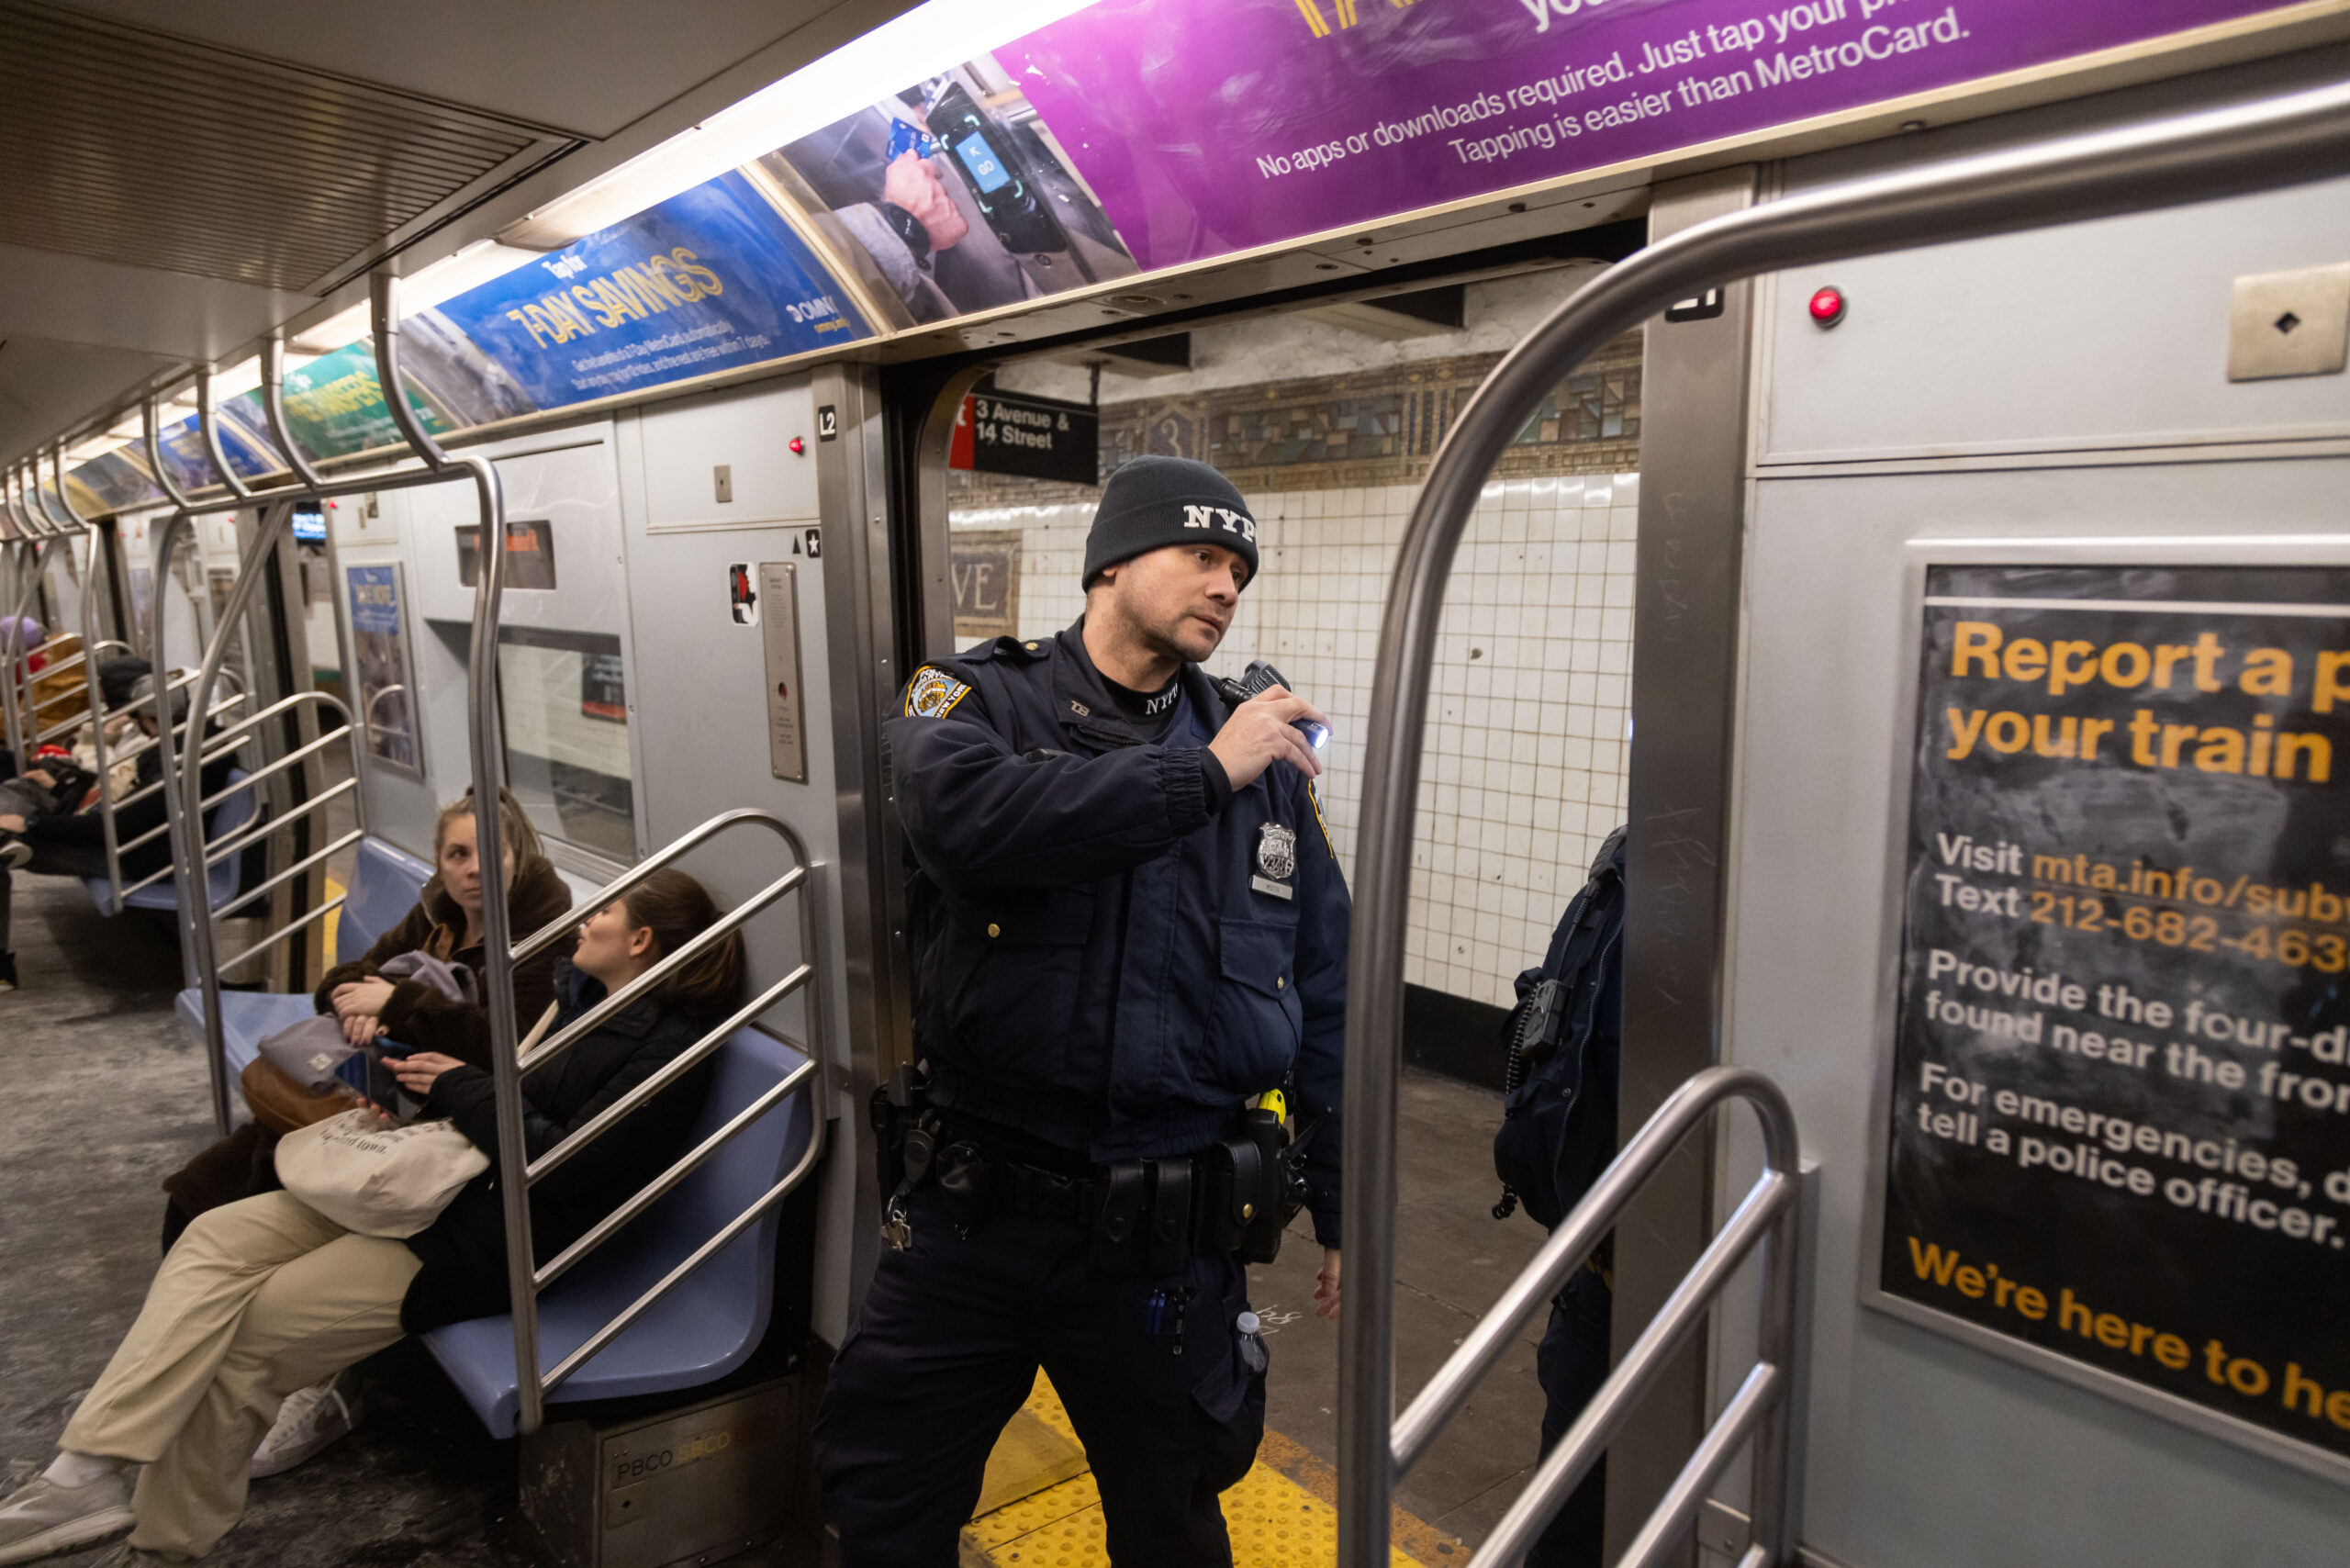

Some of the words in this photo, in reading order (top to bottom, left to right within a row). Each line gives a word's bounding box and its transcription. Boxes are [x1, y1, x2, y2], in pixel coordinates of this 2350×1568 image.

[1257, 153, 1292, 179] No
[1292, 139, 1346, 175] apps
[1346, 130, 1370, 154] or
[1372, 92, 1506, 147] downloads
[1506, 51, 1634, 110] required.
[1638, 30, 1706, 73] Just
[1707, 17, 1765, 51] tap
[1768, 0, 1848, 43] your
[1448, 122, 1556, 164] Tapping
[1556, 113, 1583, 140] is
[1584, 89, 1673, 131] easier
[1677, 69, 1754, 108] than
[1755, 6, 1972, 89] MetroCard.
[506, 291, 596, 349] 7-DAY
[572, 247, 723, 329] SAVINGS
[819, 411, 836, 436] L2
[976, 400, 989, 419] 3
[992, 402, 1052, 428] Avenue
[1056, 413, 1070, 431] &
[976, 421, 997, 441] 14
[1002, 426, 1053, 450] Street
[1183, 504, 1256, 542] NYP
[1952, 620, 2225, 696] Report
[2238, 645, 2295, 697] a
[1946, 707, 2115, 761] your
[2129, 708, 2333, 783] train
[1934, 874, 2020, 917] Text
[2031, 890, 2350, 973] 212-682-463
[1937, 832, 2023, 877] Visit
[2032, 853, 2350, 924] mta.info/sub
[1928, 948, 2087, 1012] Provide
[2097, 982, 2173, 1029] the
[1924, 990, 2043, 1044] found
[2052, 1024, 2155, 1070] near
[2165, 1041, 2246, 1091] the
[1917, 1103, 1978, 1147] tell
[1985, 1128, 2010, 1157] a
[2019, 1131, 2155, 1195] police
[2164, 1170, 2345, 1249] officer.
[1919, 1061, 1986, 1107] For
[1993, 1083, 2312, 1199] emergencies,
[1908, 1236, 2049, 1321] We're
[2058, 1287, 2191, 1370] here
[2203, 1338, 2270, 1397] to
[617, 1449, 674, 1481] PBCO
